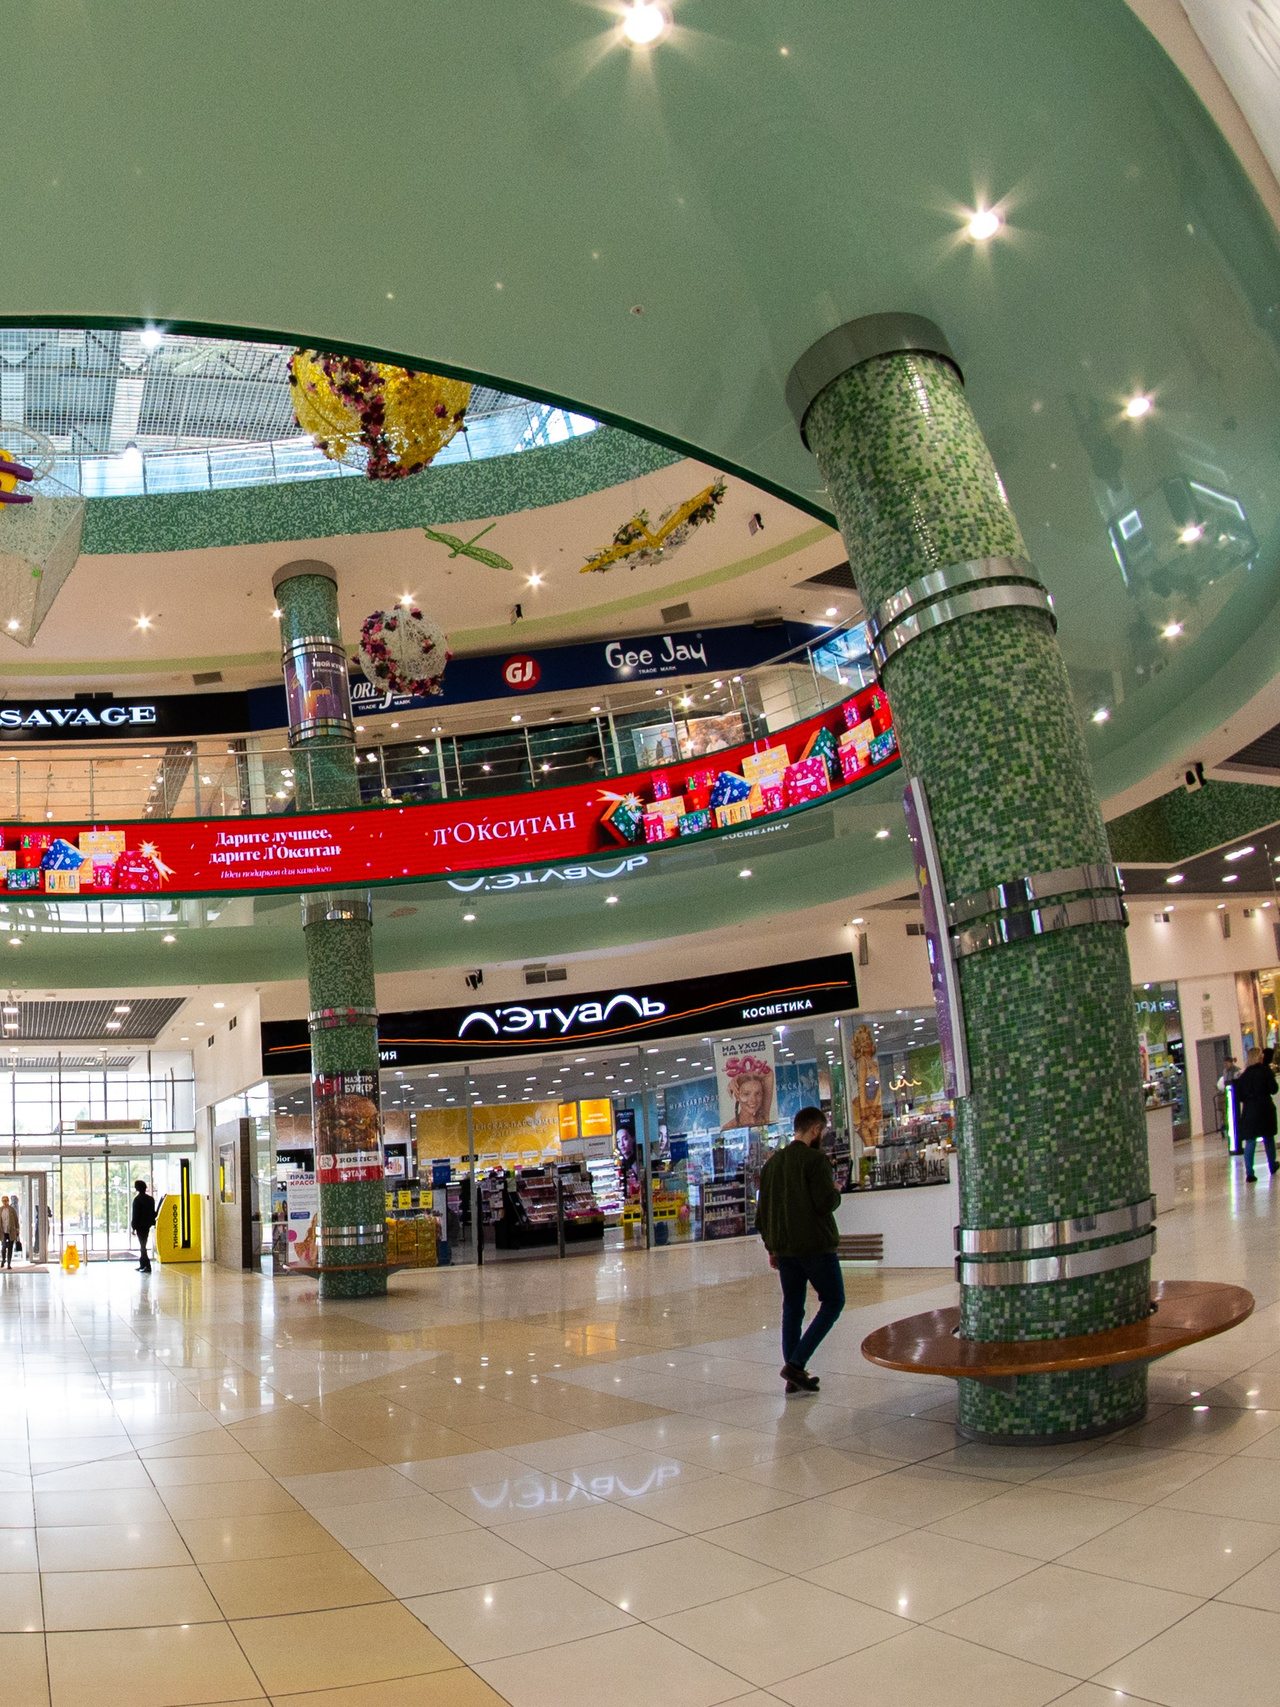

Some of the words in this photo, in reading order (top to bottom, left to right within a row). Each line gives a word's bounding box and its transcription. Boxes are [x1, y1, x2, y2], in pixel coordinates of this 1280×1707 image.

[605, 642, 653, 669] Gee
[661, 636, 707, 667] Jay
[506, 661, 534, 683] GJ
[0, 706, 157, 728] SAVAGE
[215, 832, 270, 848] Дарите
[272, 828, 333, 845] лучшее,
[208, 850, 261, 865] дарите
[742, 999, 813, 1019] КОСМЕТИКА
[722, 1044, 736, 1053] НА
[738, 1040, 766, 1050] УХОД
[344, 1083, 374, 1093] БУРГЕР
